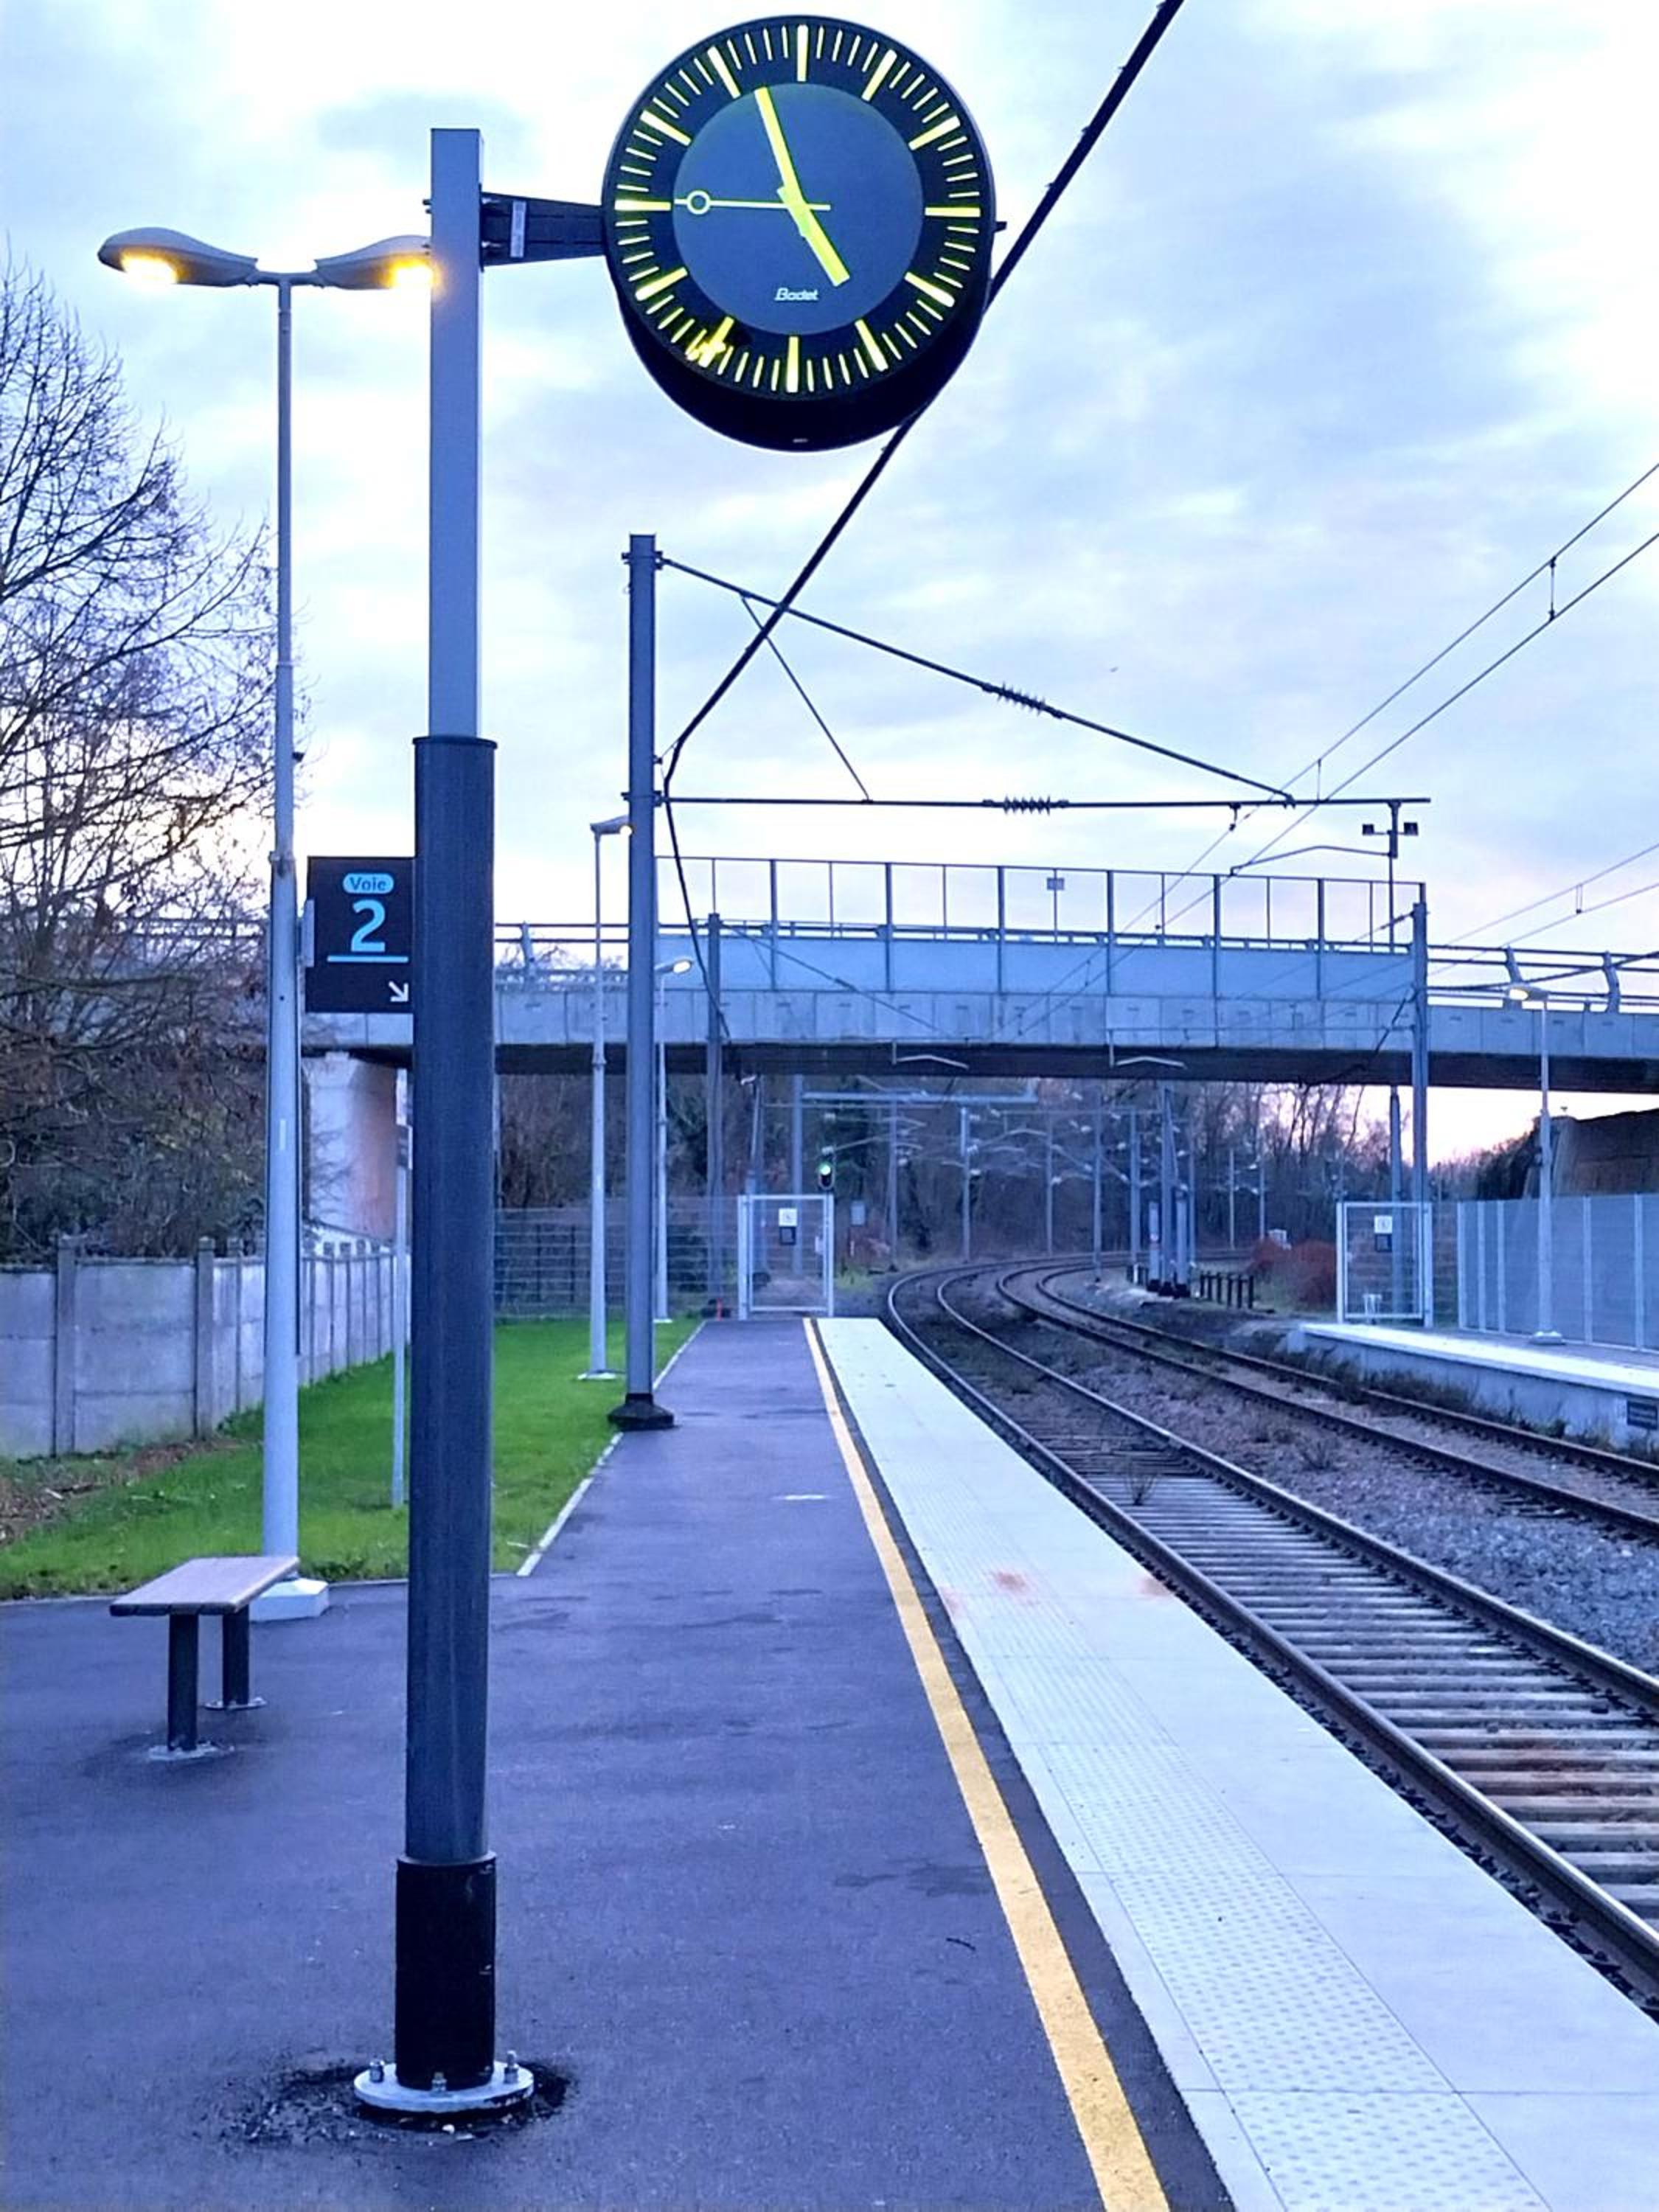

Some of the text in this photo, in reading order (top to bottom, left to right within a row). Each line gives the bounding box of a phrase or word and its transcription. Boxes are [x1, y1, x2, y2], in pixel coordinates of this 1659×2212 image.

[774, 287, 818, 301] Bodet
[349, 877, 386, 891] Voie
[351, 900, 385, 951] 2
